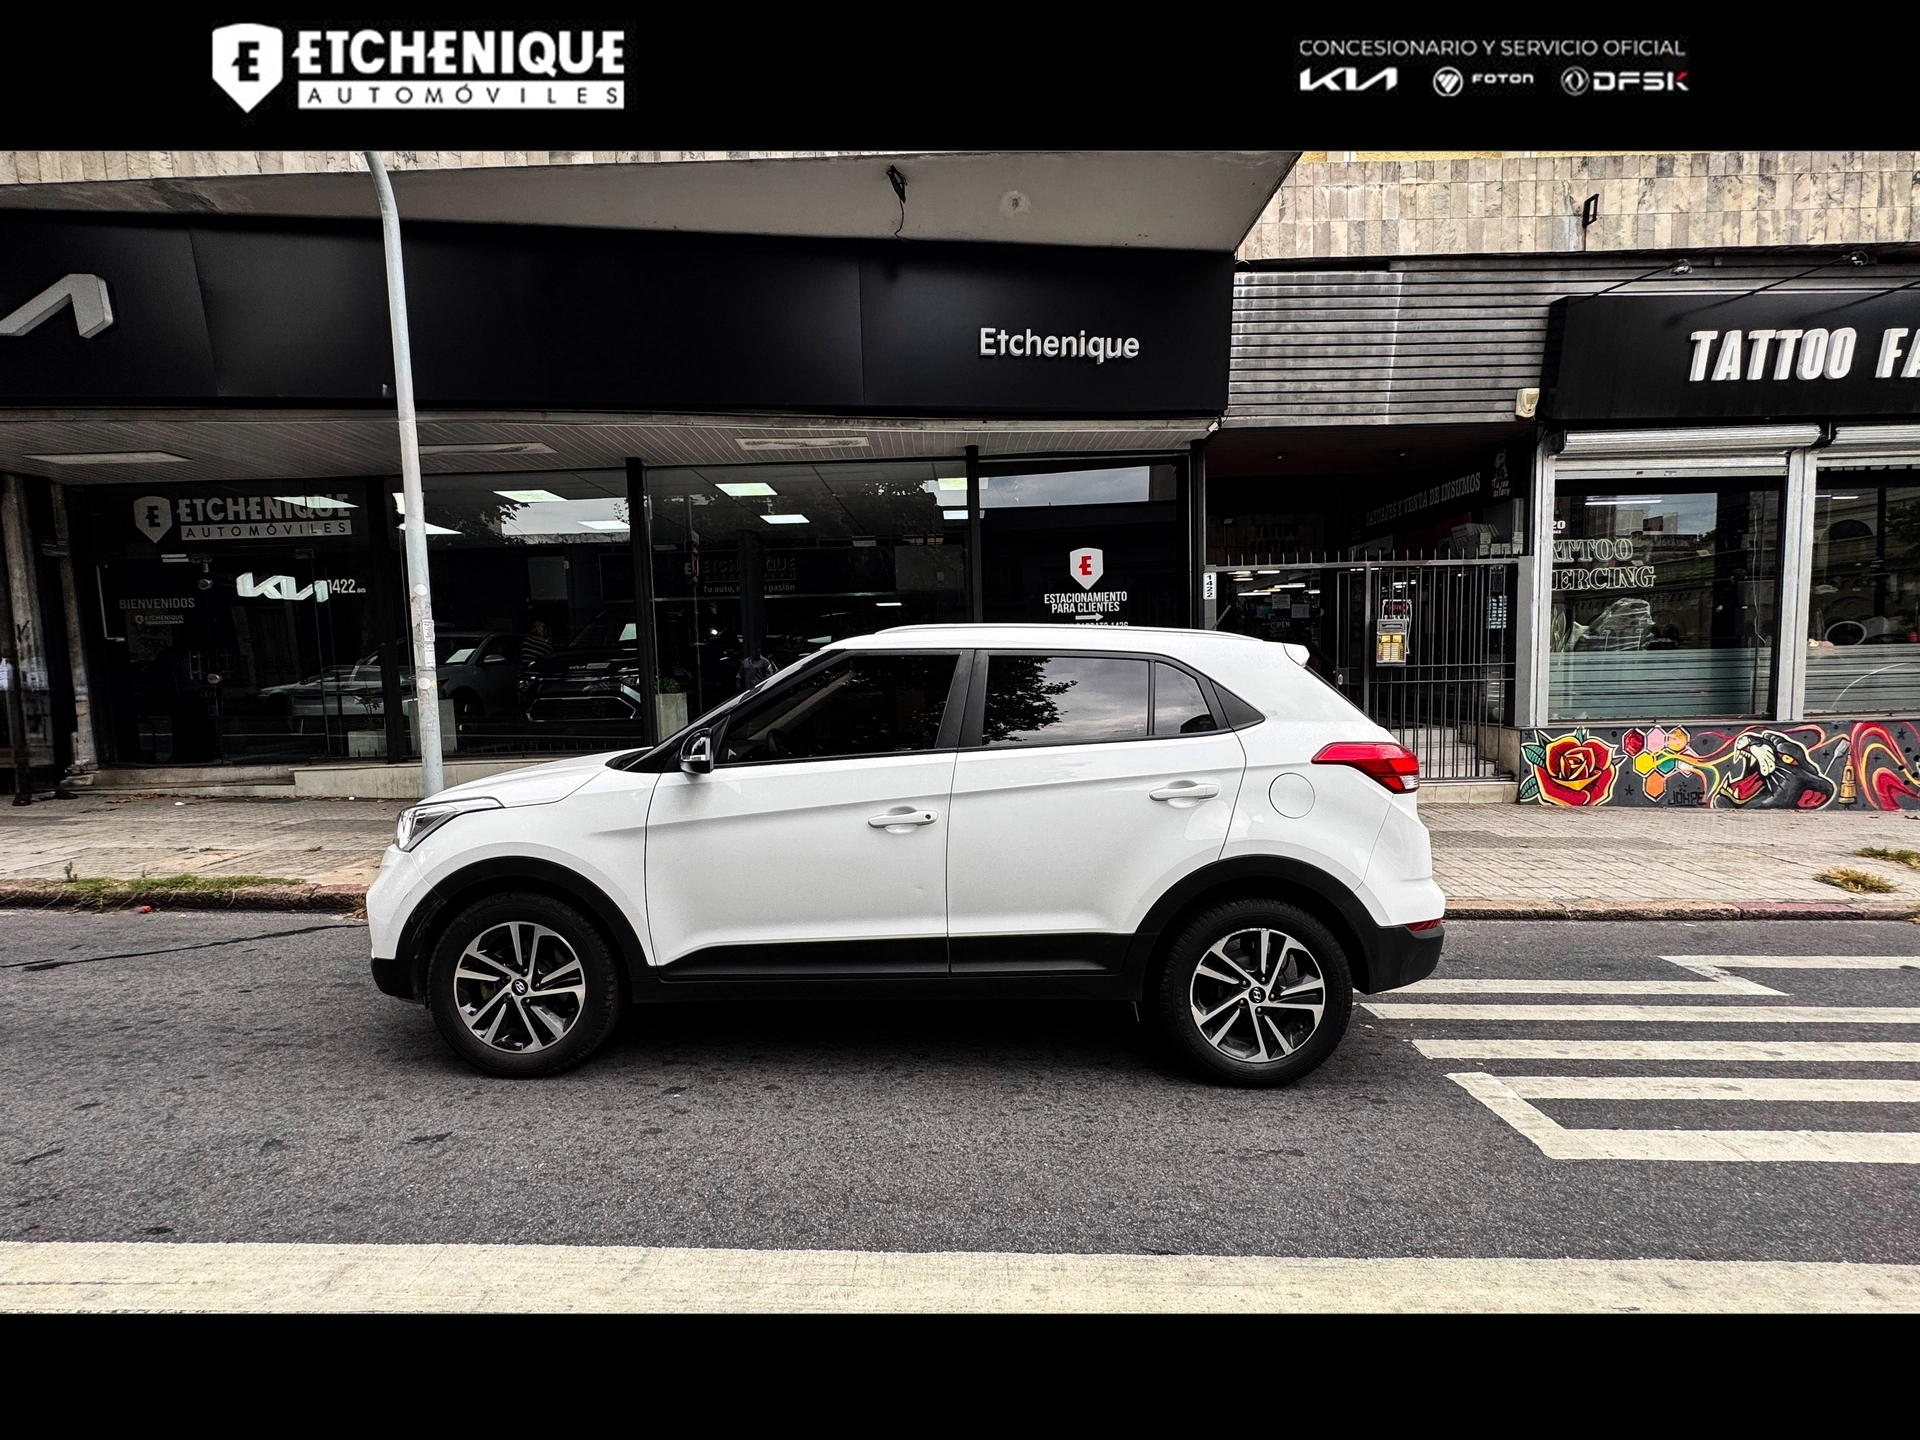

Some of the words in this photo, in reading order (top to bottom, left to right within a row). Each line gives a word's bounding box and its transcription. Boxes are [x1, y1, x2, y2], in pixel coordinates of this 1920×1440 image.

[980, 327, 1140, 365] Etchenique
[1689, 327, 1857, 382] TATTOO
[1404, 490, 1428, 514] VENTA
[1429, 486, 1440, 506] DE
[1441, 471, 1481, 502] INSUMOS
[186, 522, 346, 538] AUTOMÓVILES
[327, 578, 356, 594] 1422
[119, 597, 195, 609] BIENVENIDOS
[1044, 591, 1127, 604] ESTACIONAMIENTO
[1051, 603, 1076, 613] PARA
[1078, 602, 1120, 613] CLIENTES
